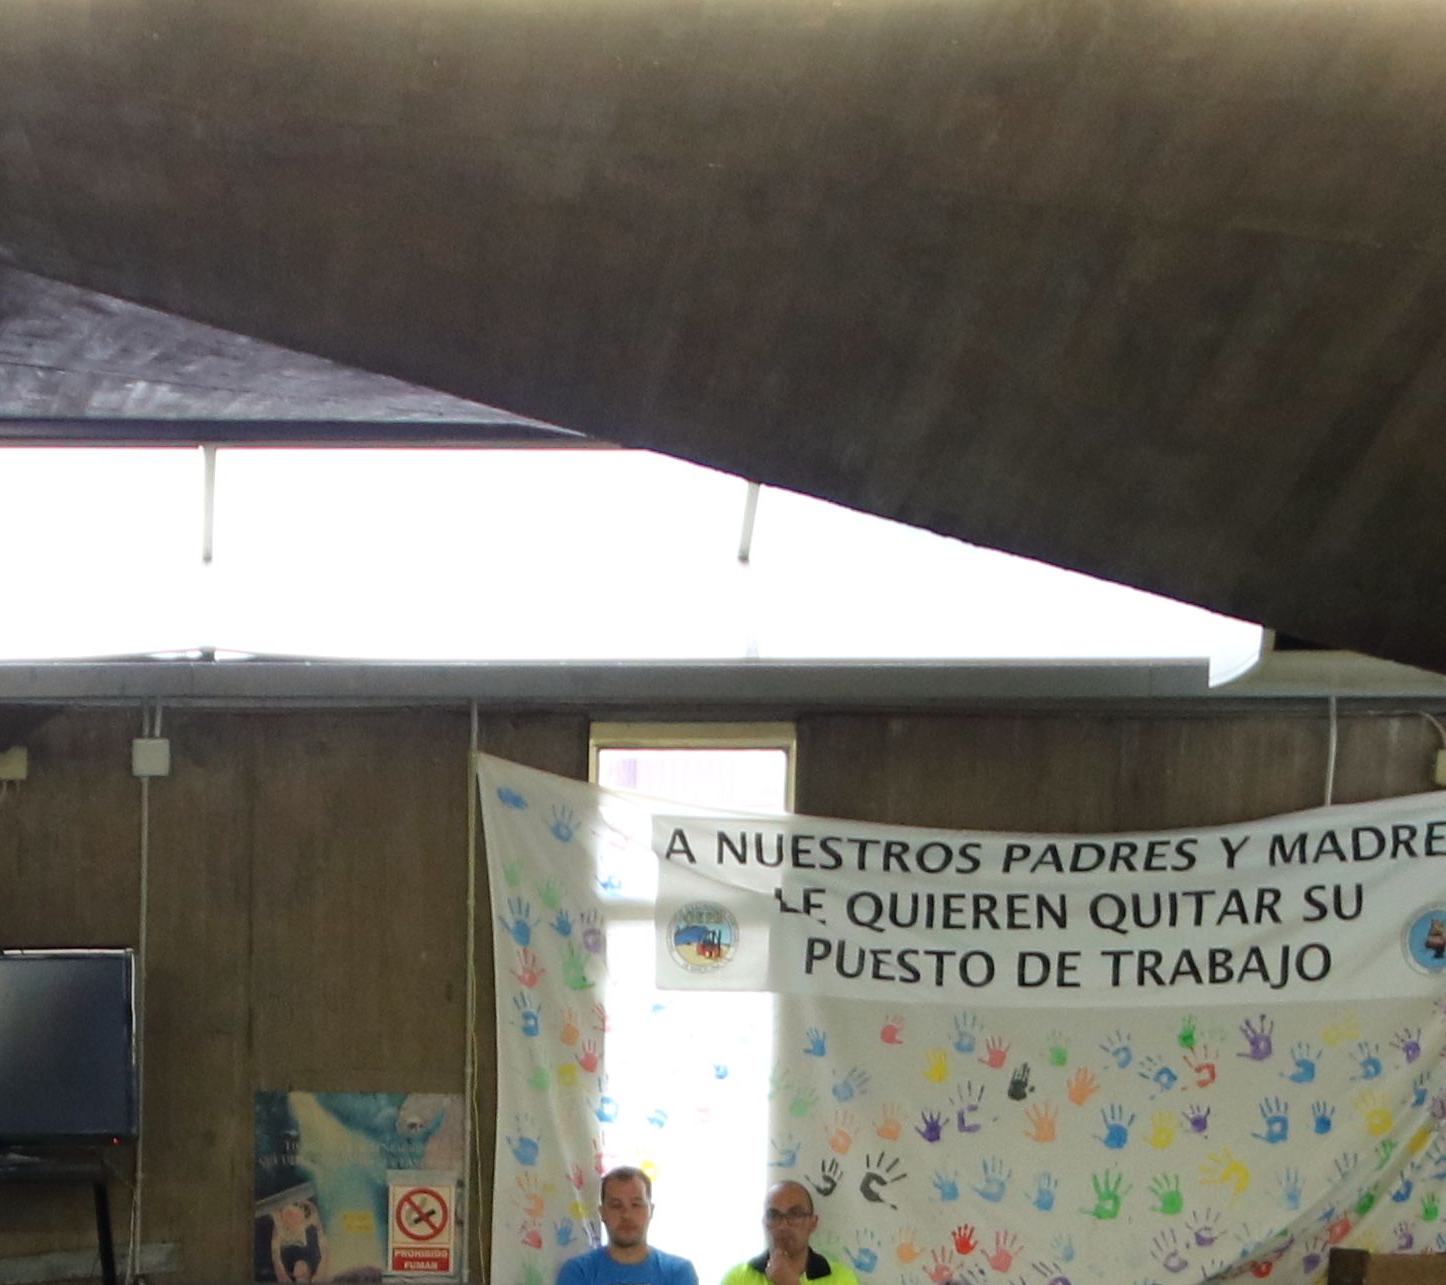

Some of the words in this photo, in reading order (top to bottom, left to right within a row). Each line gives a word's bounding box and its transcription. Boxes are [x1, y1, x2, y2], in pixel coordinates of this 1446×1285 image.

[665, 830, 697, 865] A
[717, 833, 984, 876] NUESTROS
[1002, 839, 1198, 874] PADRES
[1221, 836, 1247, 866] Y
[846, 887, 1070, 934] QUIEREN
[1089, 889, 1285, 935] QUITAR
[1302, 882, 1364, 922] SU
[804, 941, 996, 988] PUESTO
[1018, 945, 1082, 988] DE
[1102, 942, 1333, 988] TRABAJO
[394, 1249, 448, 1259] PROHIBIDO
[403, 1261, 439, 1271] FUMAR
